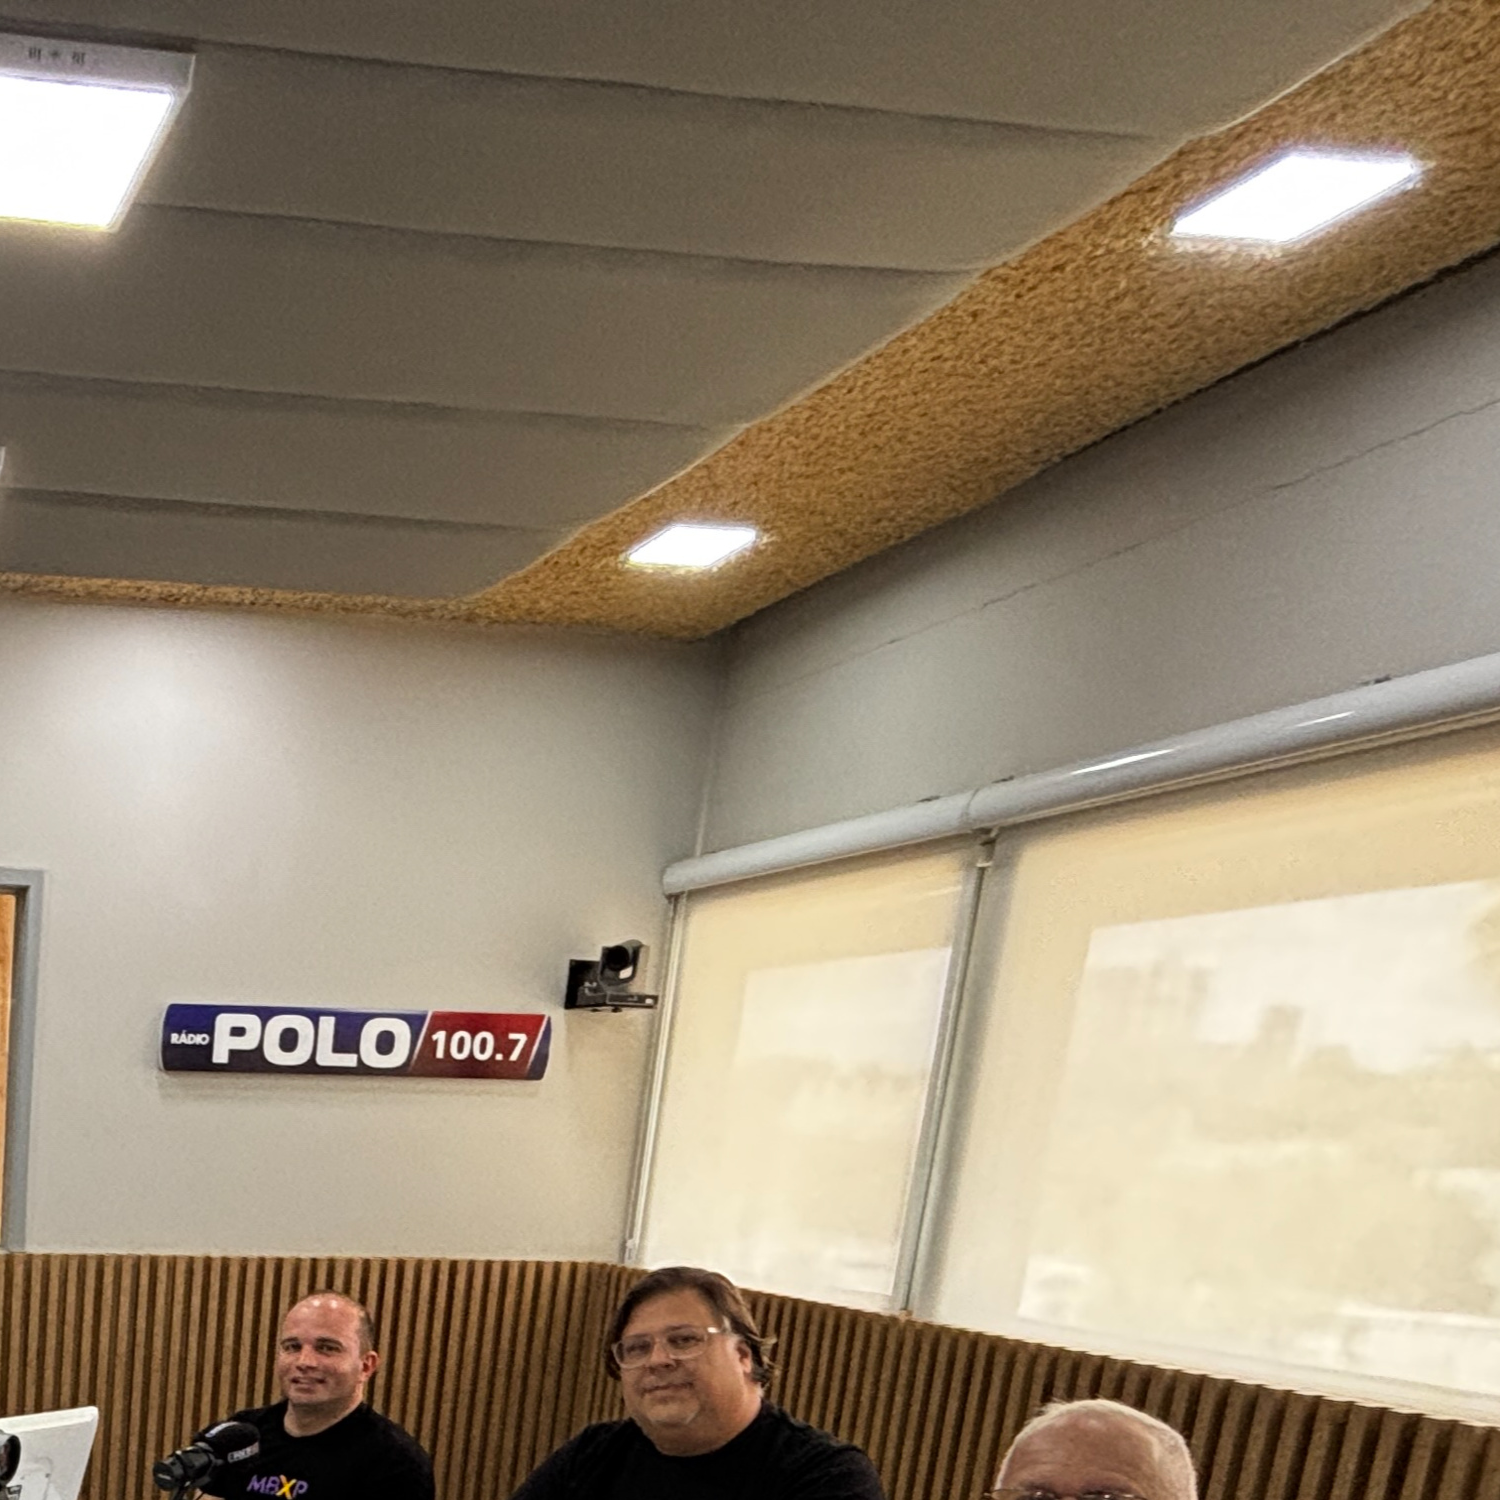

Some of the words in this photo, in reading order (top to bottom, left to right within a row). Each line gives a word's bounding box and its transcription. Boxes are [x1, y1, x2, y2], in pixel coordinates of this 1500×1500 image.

[170, 1030, 210, 1045] RÁDIO
[212, 1013, 411, 1068] POLO
[431, 1030, 528, 1063] 100.7
[247, 1475, 308, 1500] MBXP
